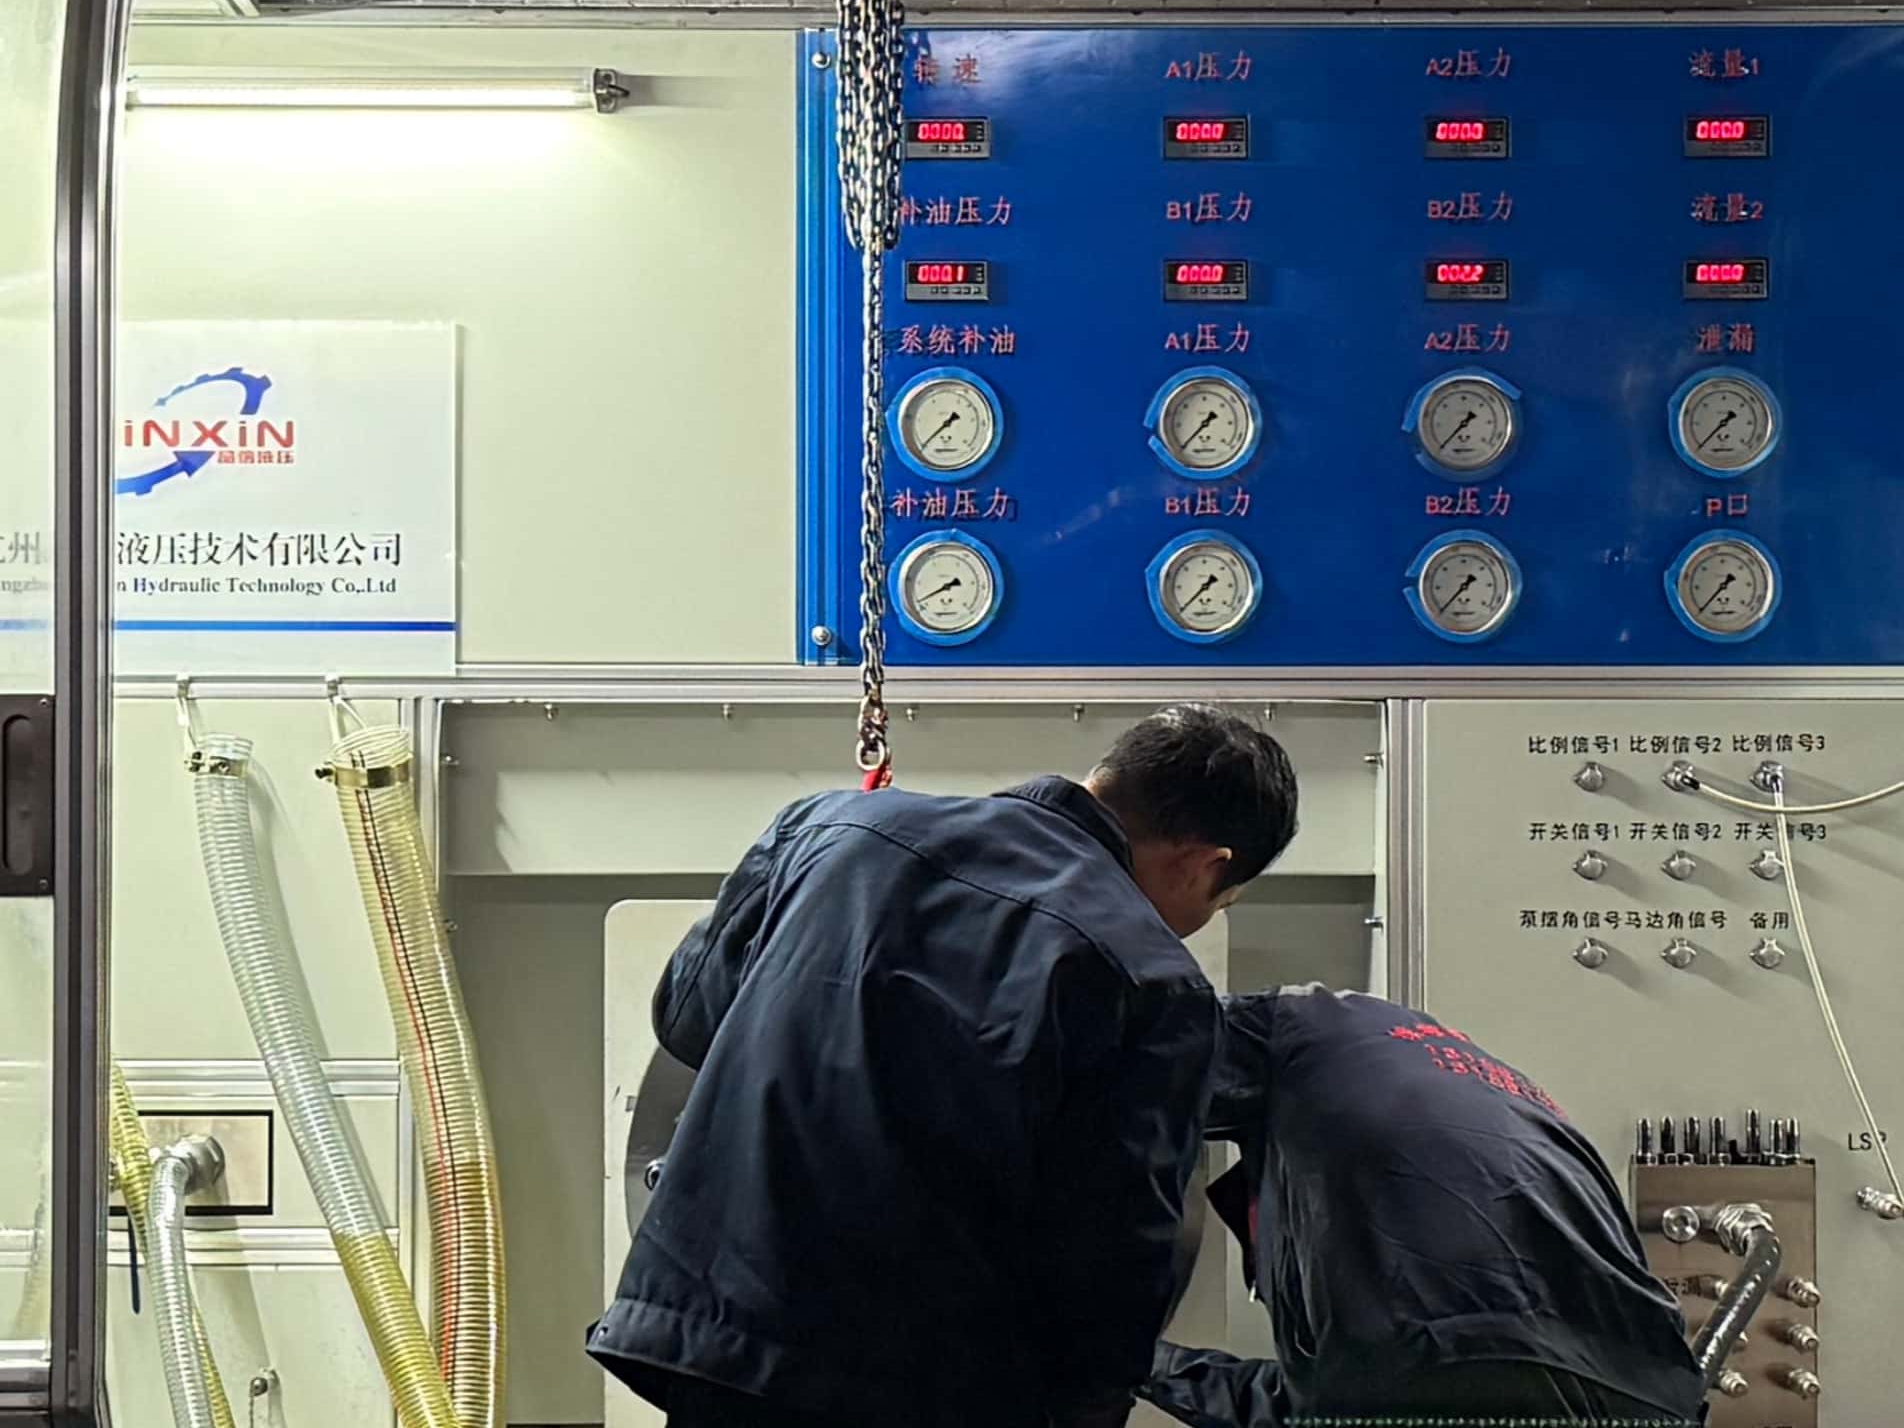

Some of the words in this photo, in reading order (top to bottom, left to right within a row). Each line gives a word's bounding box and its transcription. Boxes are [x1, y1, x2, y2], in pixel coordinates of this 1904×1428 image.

[1165, 51, 1252, 82] A1压力
[1426, 48, 1511, 78] A2压力
[897, 196, 1013, 226] 补油压力
[1166, 192, 1252, 222] B1压力
[1428, 192, 1513, 221] B2压力
[898, 325, 1016, 355] 系统补油
[1165, 323, 1250, 353] A1压力
[1424, 323, 1511, 352] A2压力
[890, 487, 1009, 518] 补油压力
[1165, 487, 1250, 516] B1压力
[1425, 486, 1511, 516] B2压力
[133, 577, 221, 595] Hydraulic
[226, 577, 323, 596] Technology
[1528, 735, 1619, 754] 比例信号1
[1630, 735, 1722, 754] 比例信号2
[1732, 734, 1826, 753] 比例信号3
[1529, 823, 1619, 842] 开关信号1
[1630, 823, 1722, 842] 开关信号2
[1748, 910, 1790, 930] 备用
